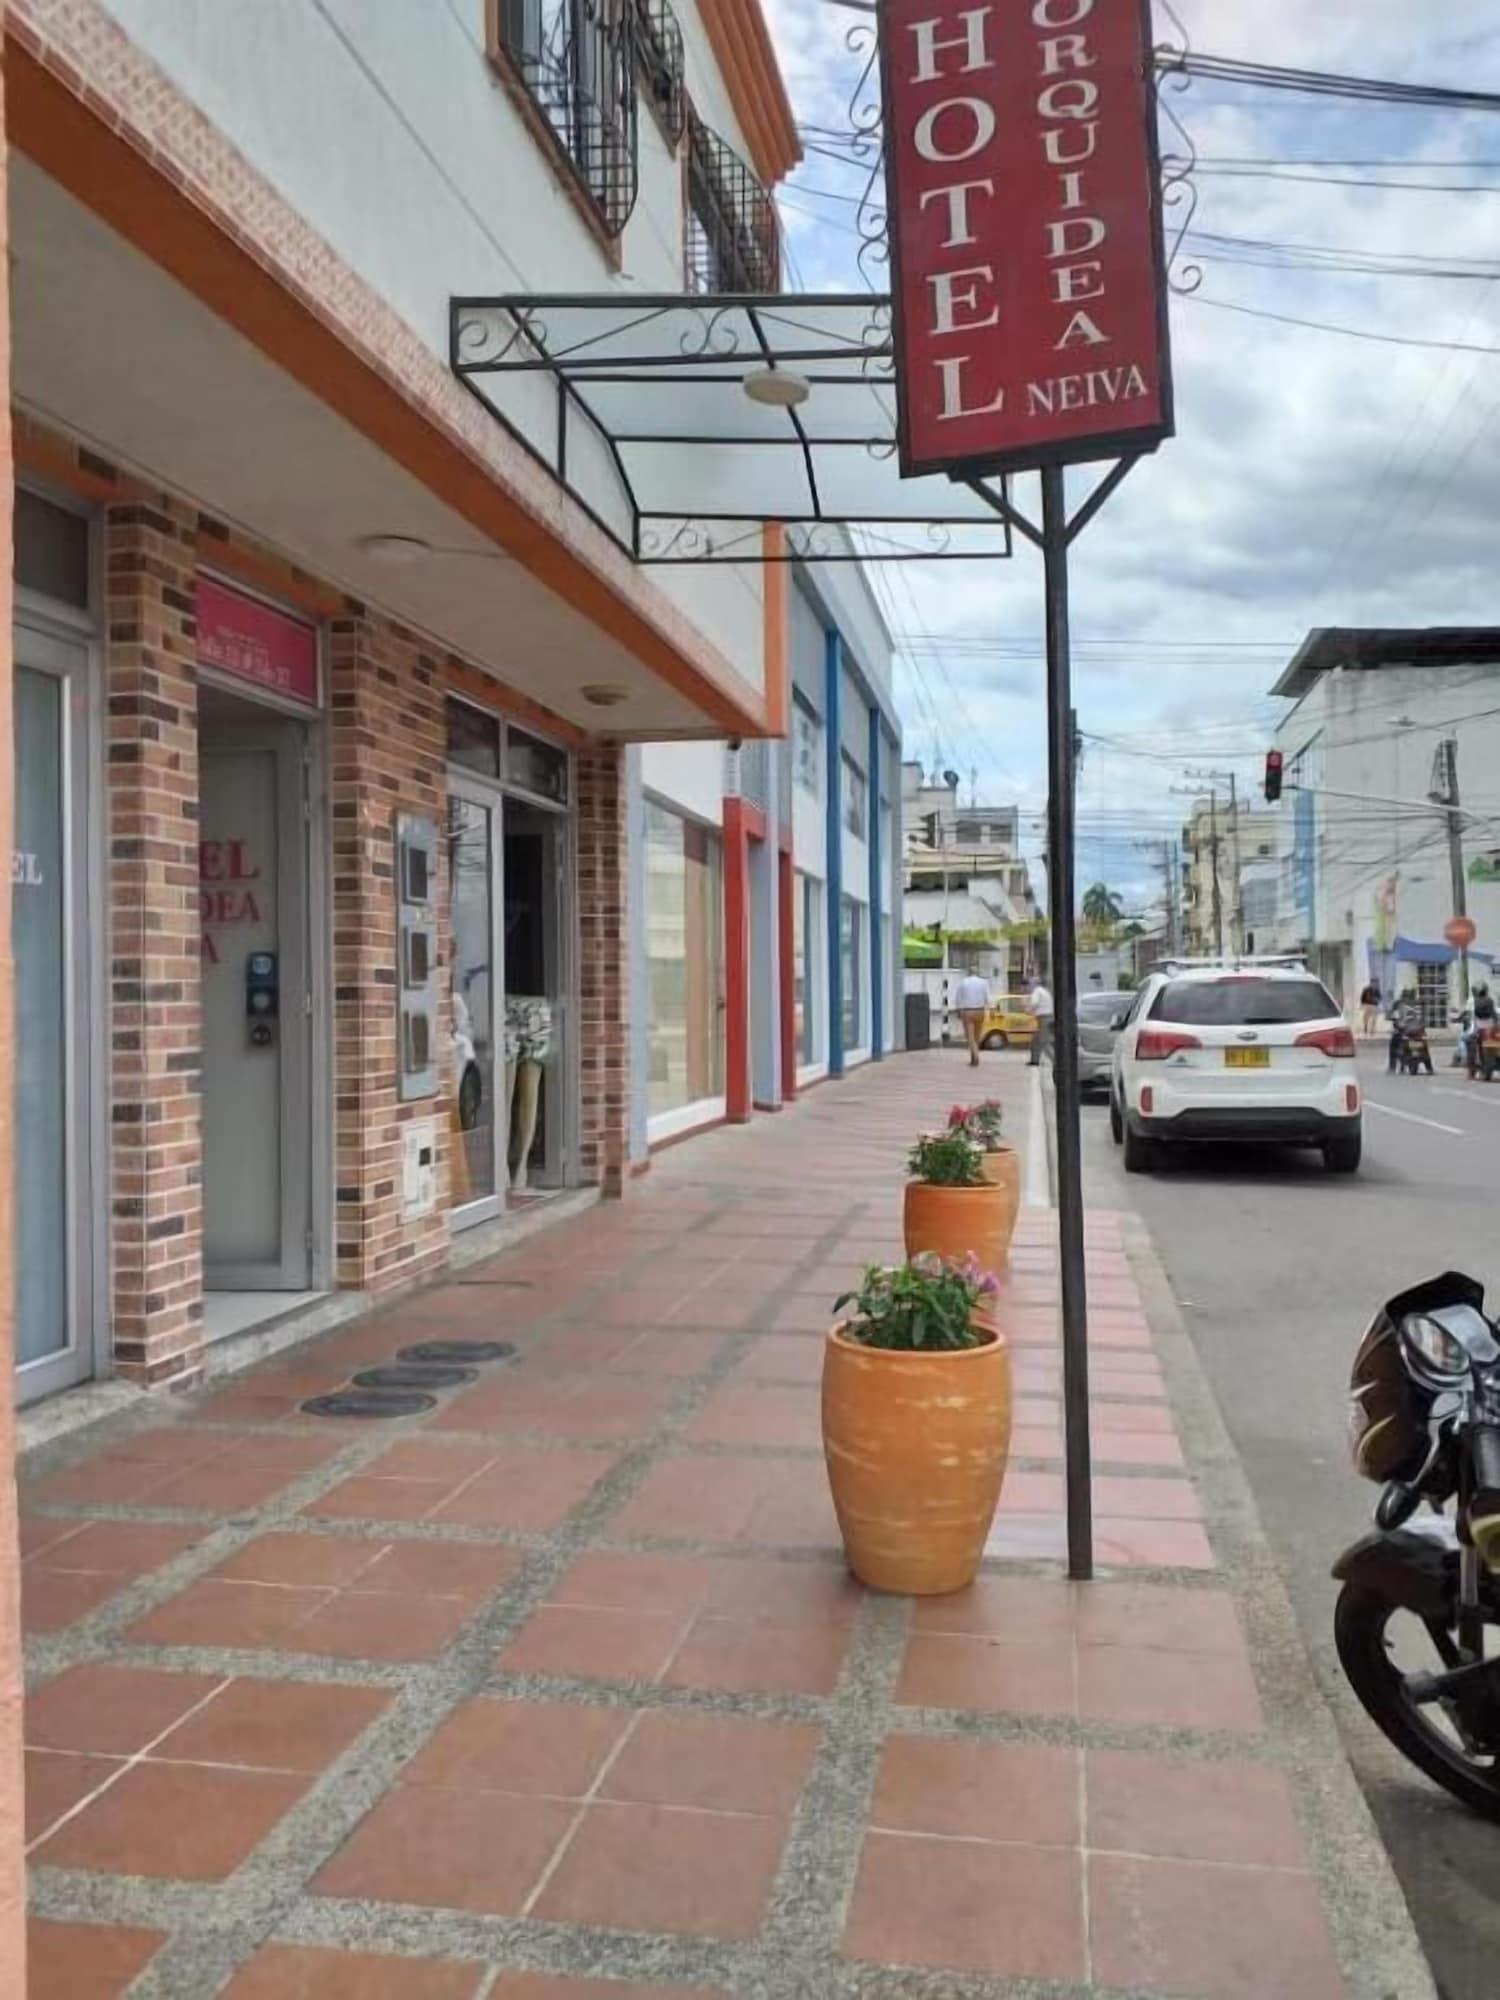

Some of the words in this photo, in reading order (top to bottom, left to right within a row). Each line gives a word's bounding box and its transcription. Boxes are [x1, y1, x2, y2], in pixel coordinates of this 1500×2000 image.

[906, 5, 1004, 421] HOTEL
[1031, 0, 1110, 350] ORQUIDEA
[1026, 364, 1149, 416] NEIVA
